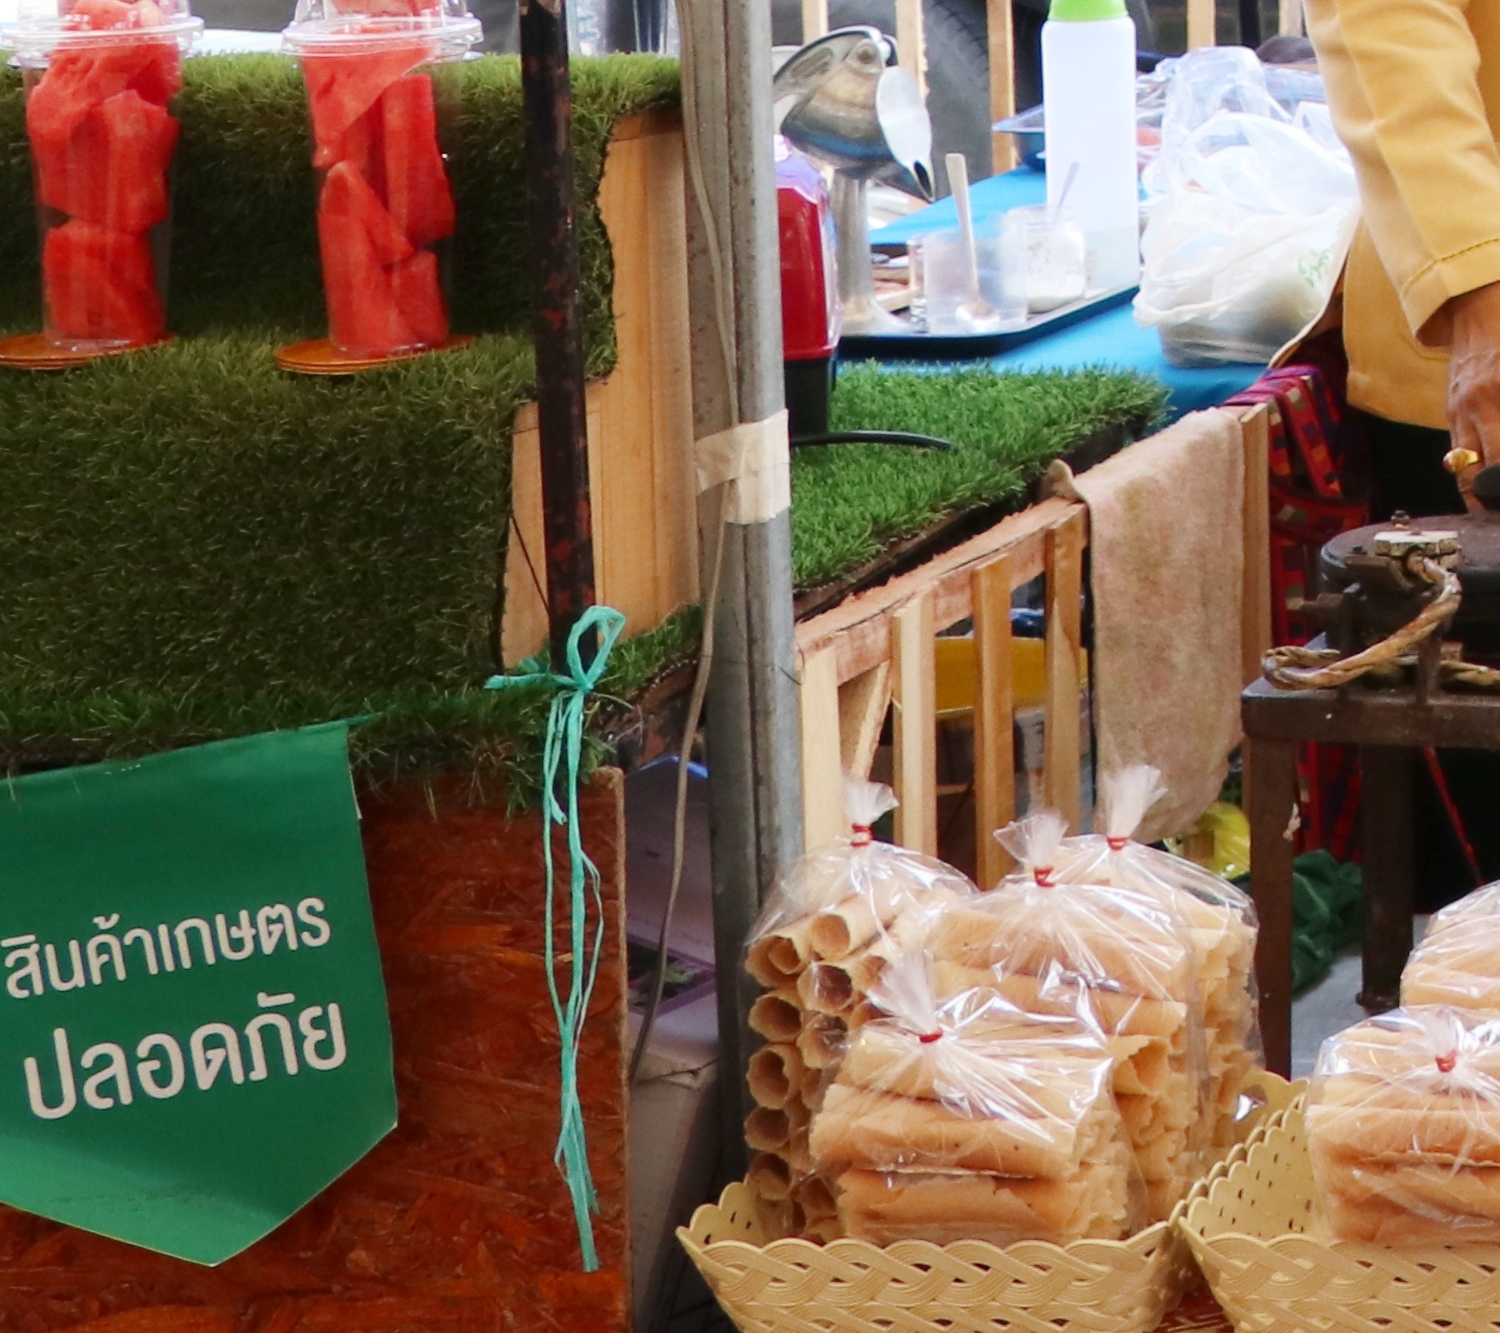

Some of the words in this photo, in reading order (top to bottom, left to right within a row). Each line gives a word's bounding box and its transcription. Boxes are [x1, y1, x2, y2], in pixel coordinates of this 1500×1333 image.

[1, 896, 332, 1000] สินค้าเกษตร
[23, 992, 349, 1121] ปลอดภัย
